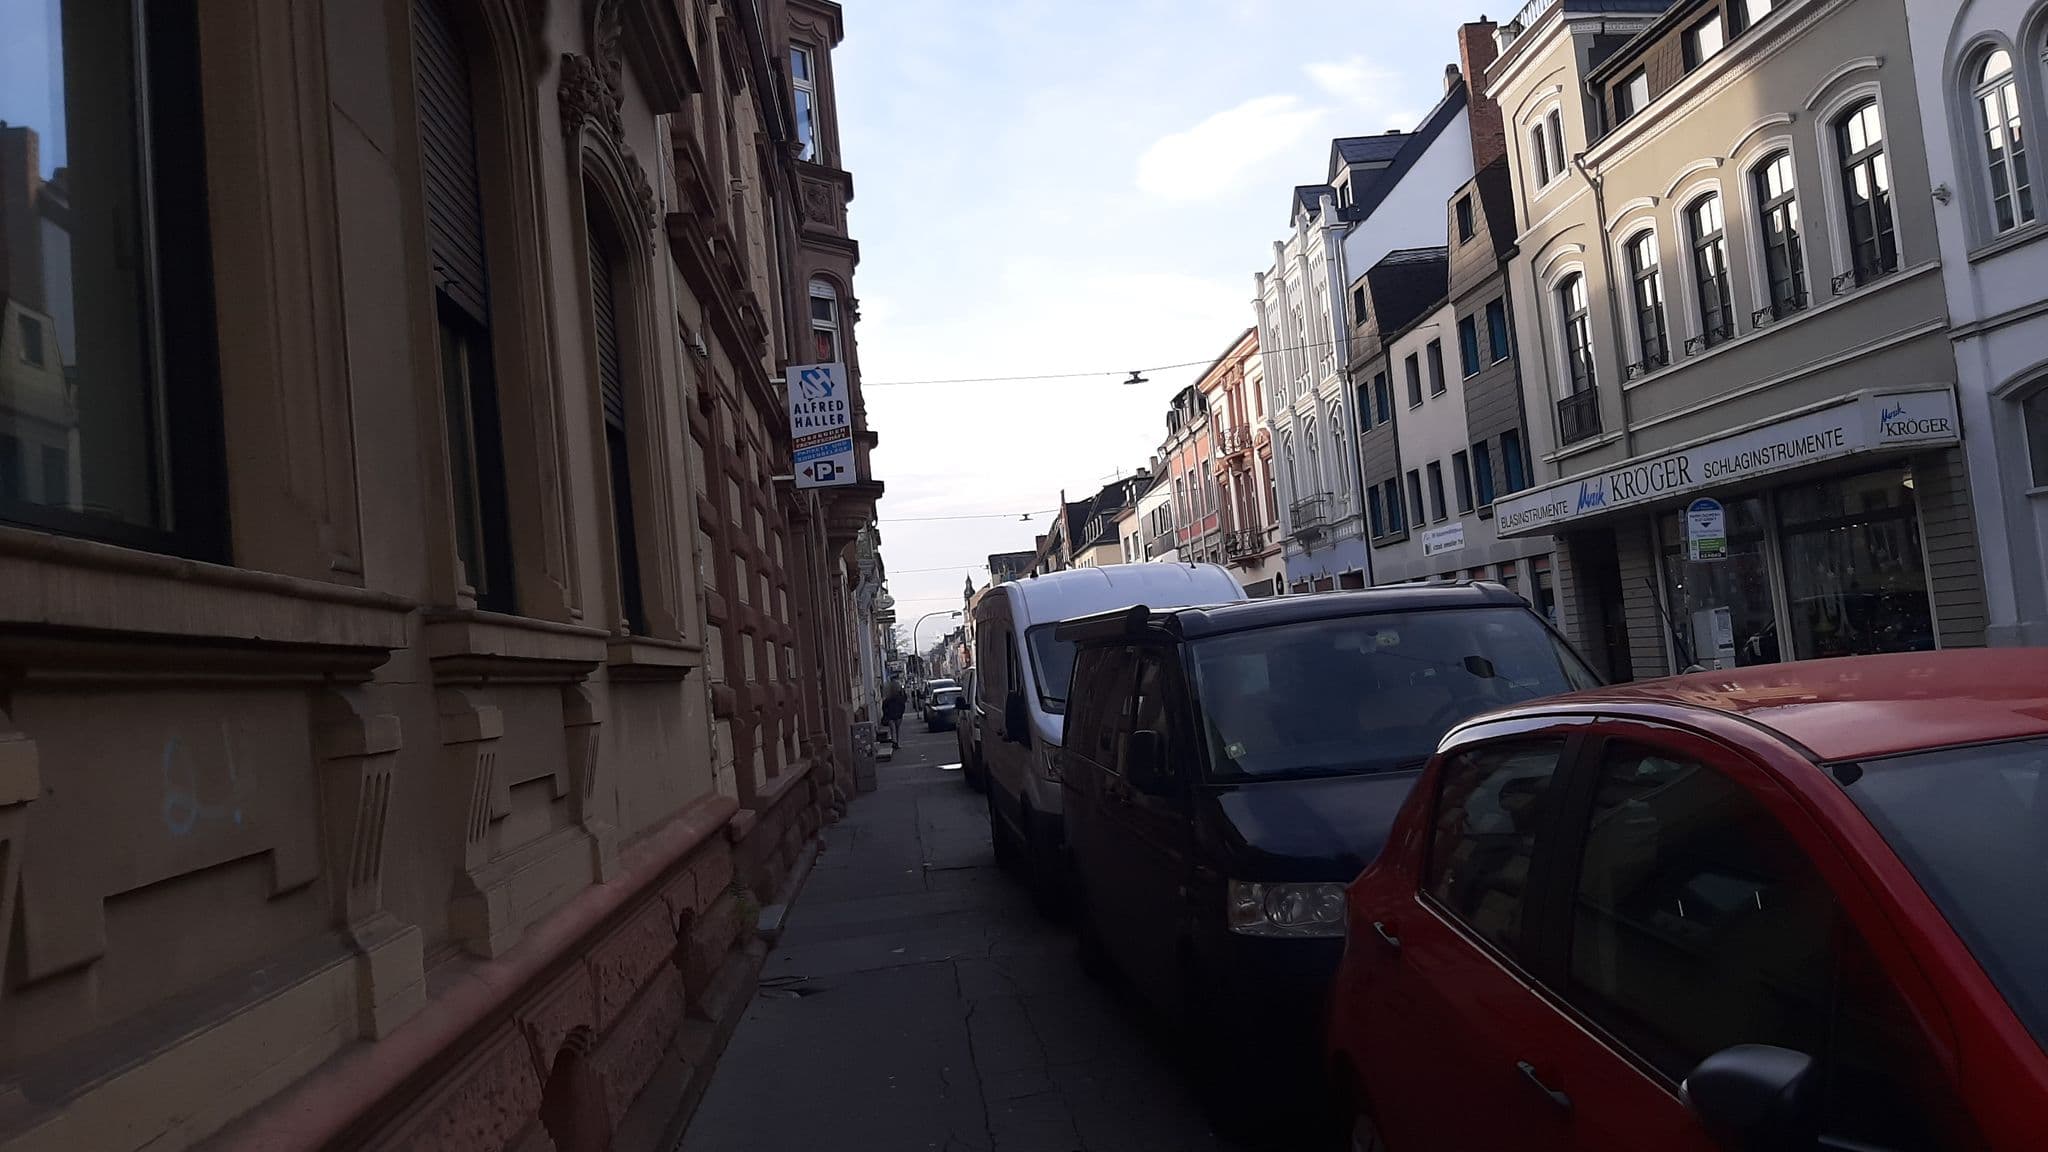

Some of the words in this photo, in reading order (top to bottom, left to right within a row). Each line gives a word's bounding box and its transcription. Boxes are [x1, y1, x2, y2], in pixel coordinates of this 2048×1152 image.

[794, 400, 844, 414] ALFRED
[795, 414, 845, 428] HALLER
[1886, 418, 1951, 437] KRÖGER
[1501, 500, 1569, 529] BLASINSTRUMENTE
[1576, 477, 1607, 515] Musik
[1610, 455, 1693, 502] KRÖGER
[1703, 427, 1845, 479] SCHLAGINSTRUMENTE
